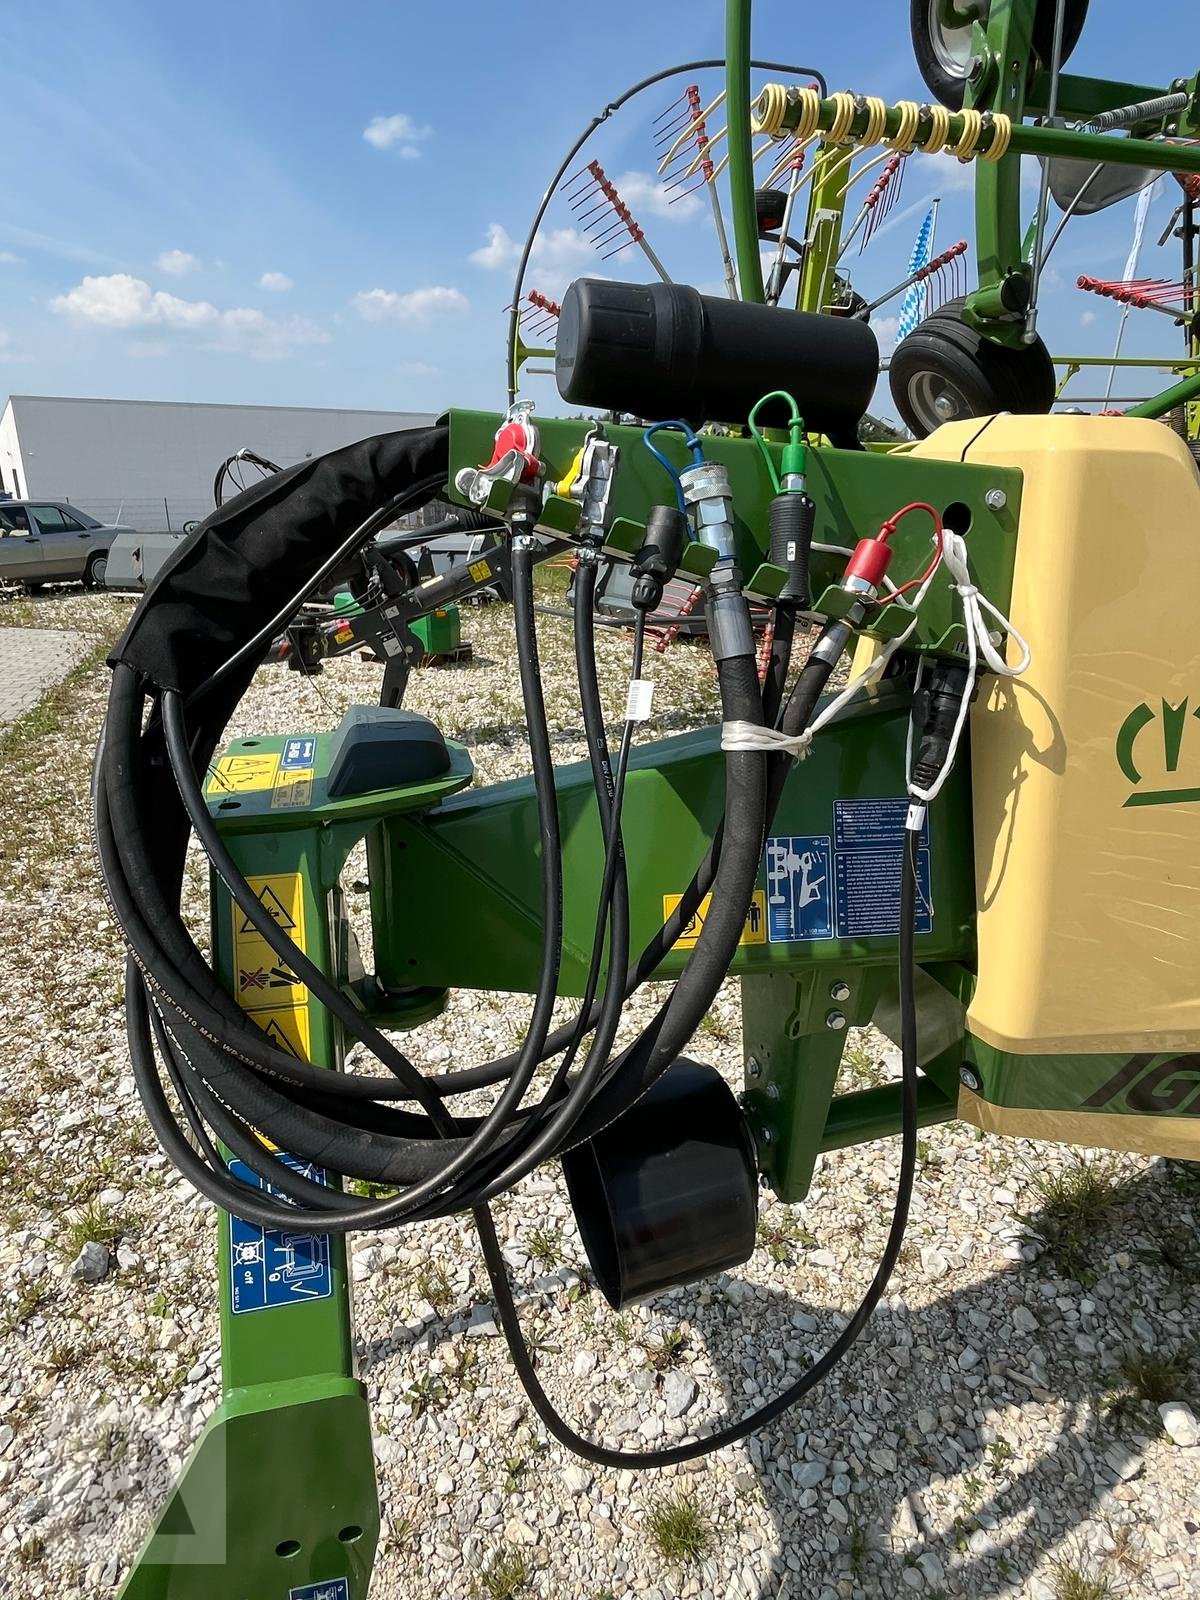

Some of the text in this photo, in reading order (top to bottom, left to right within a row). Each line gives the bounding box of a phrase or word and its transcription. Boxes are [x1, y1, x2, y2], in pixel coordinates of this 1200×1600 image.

[175, 1006, 199, 1028] DN10
[1080, 1053, 1200, 1114] IG
[244, 1270, 254, 1284] off
